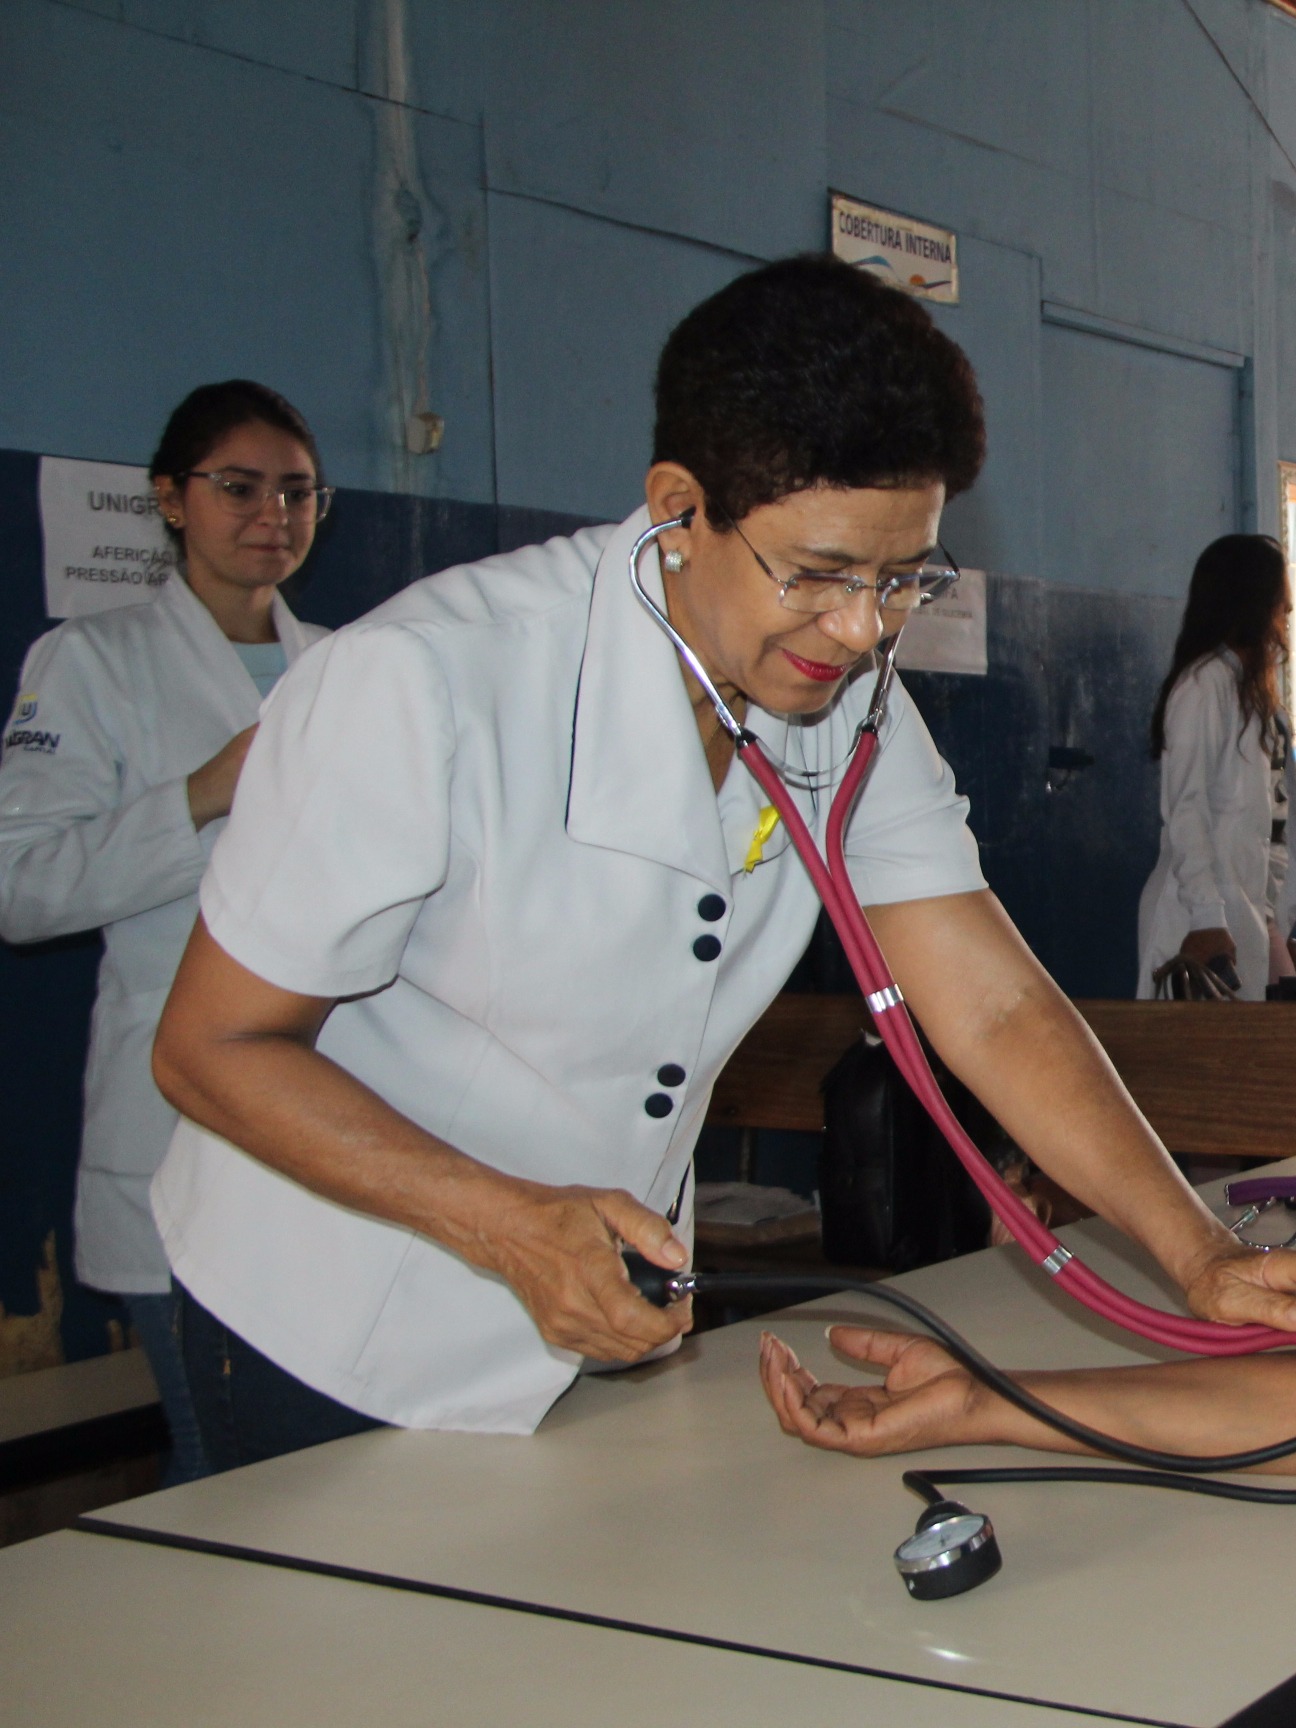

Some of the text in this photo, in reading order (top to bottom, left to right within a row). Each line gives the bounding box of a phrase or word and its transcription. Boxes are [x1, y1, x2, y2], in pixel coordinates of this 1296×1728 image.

[838, 211, 952, 263] COBERTURA INTERNA
[65, 566, 142, 584] PRESSÃO
